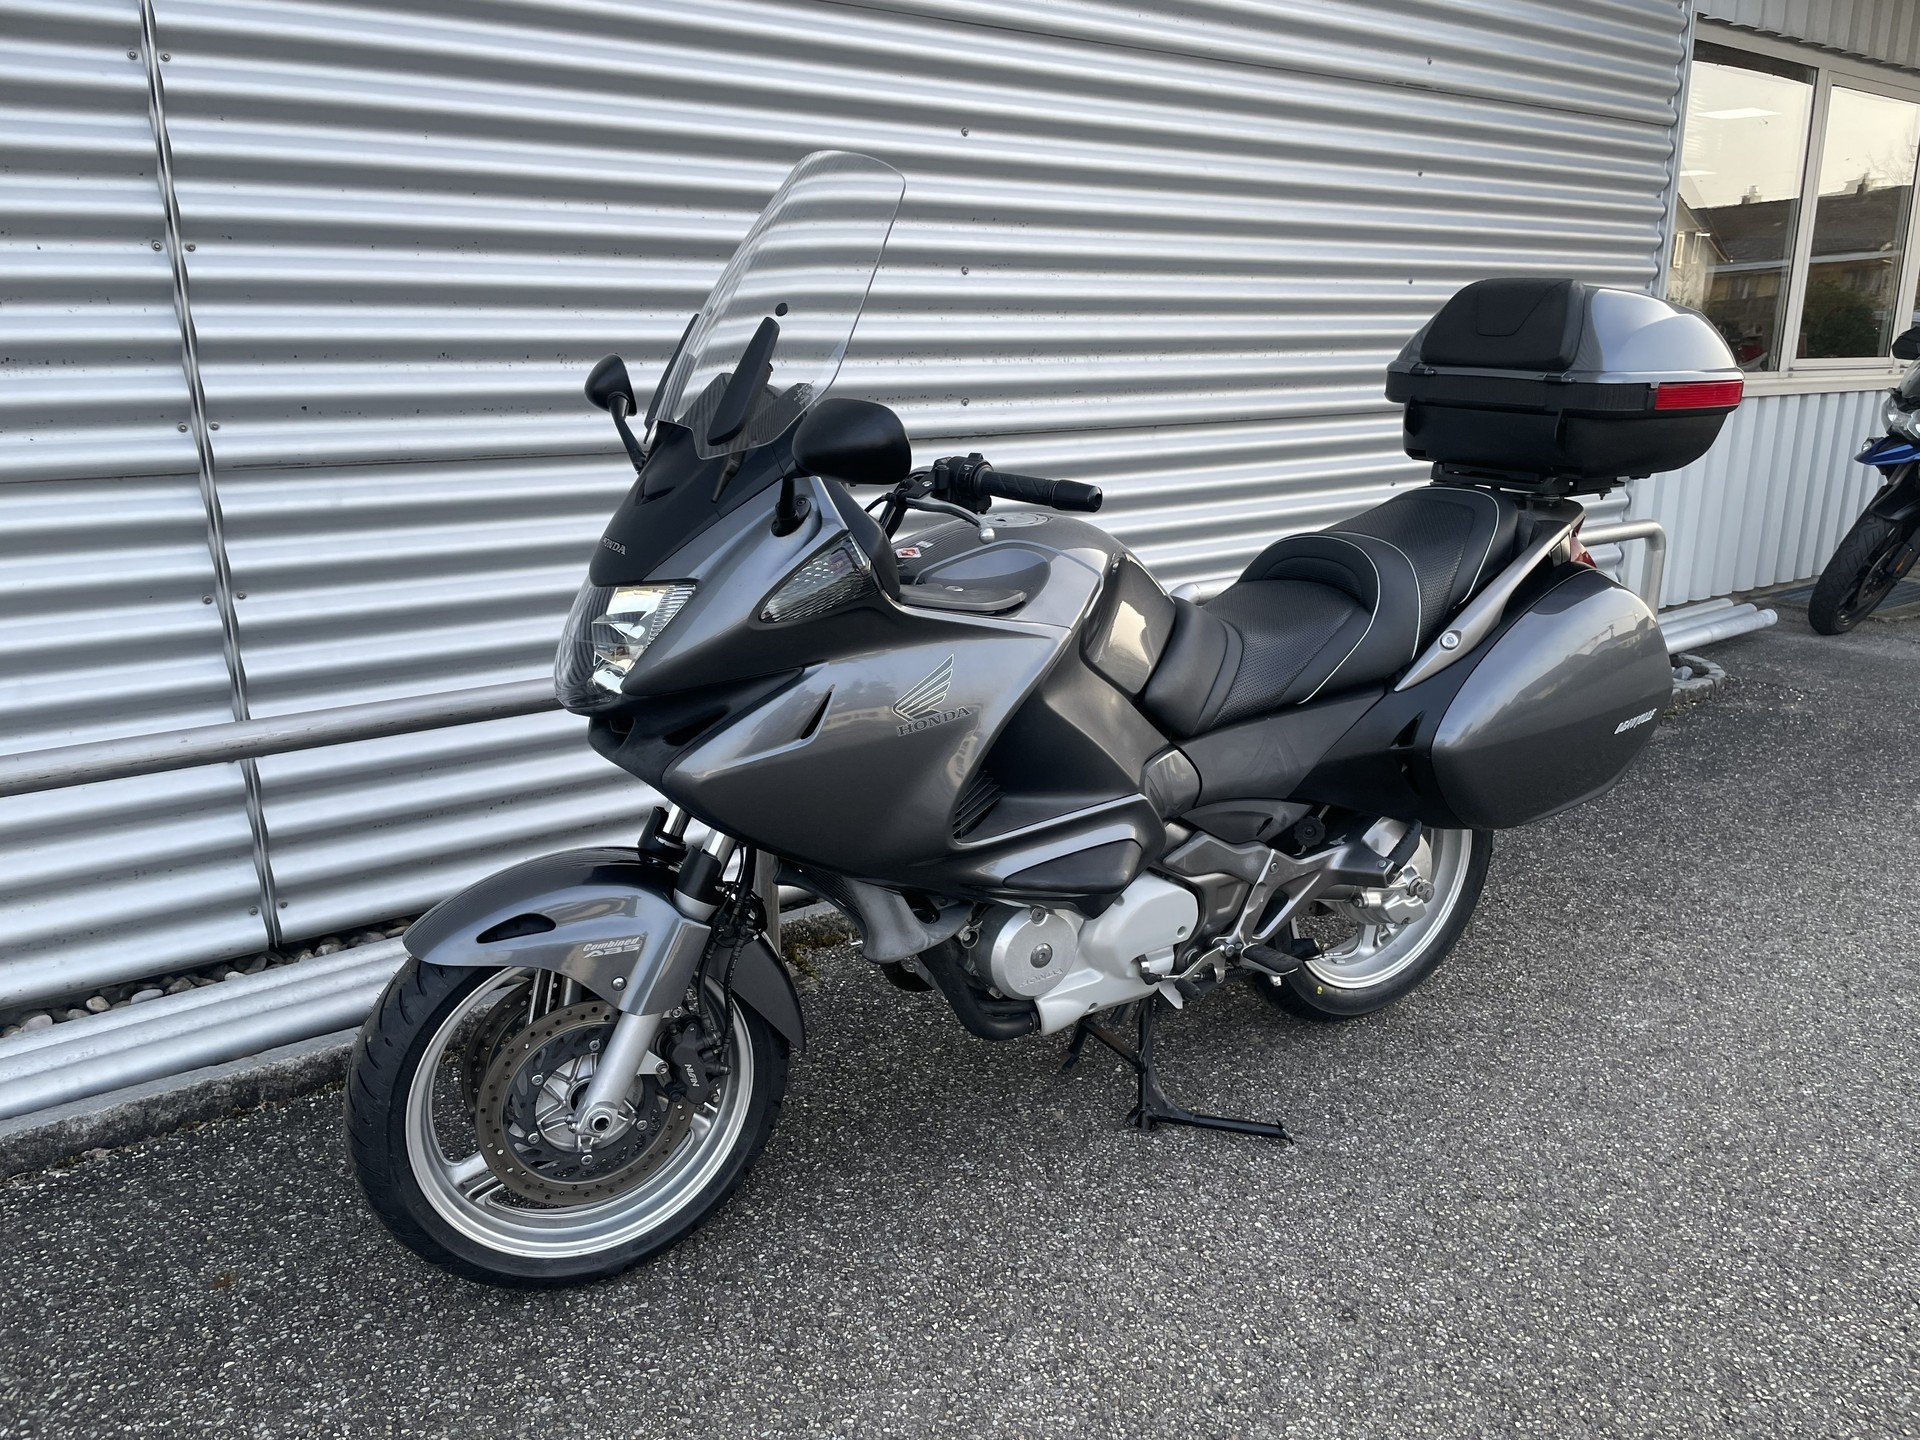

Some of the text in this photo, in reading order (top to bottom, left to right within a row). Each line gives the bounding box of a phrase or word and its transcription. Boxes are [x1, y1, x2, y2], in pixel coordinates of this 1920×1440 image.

[898, 706, 971, 737] HONDA
[583, 936, 640, 952] Combined
[583, 944, 640, 959] ABS
